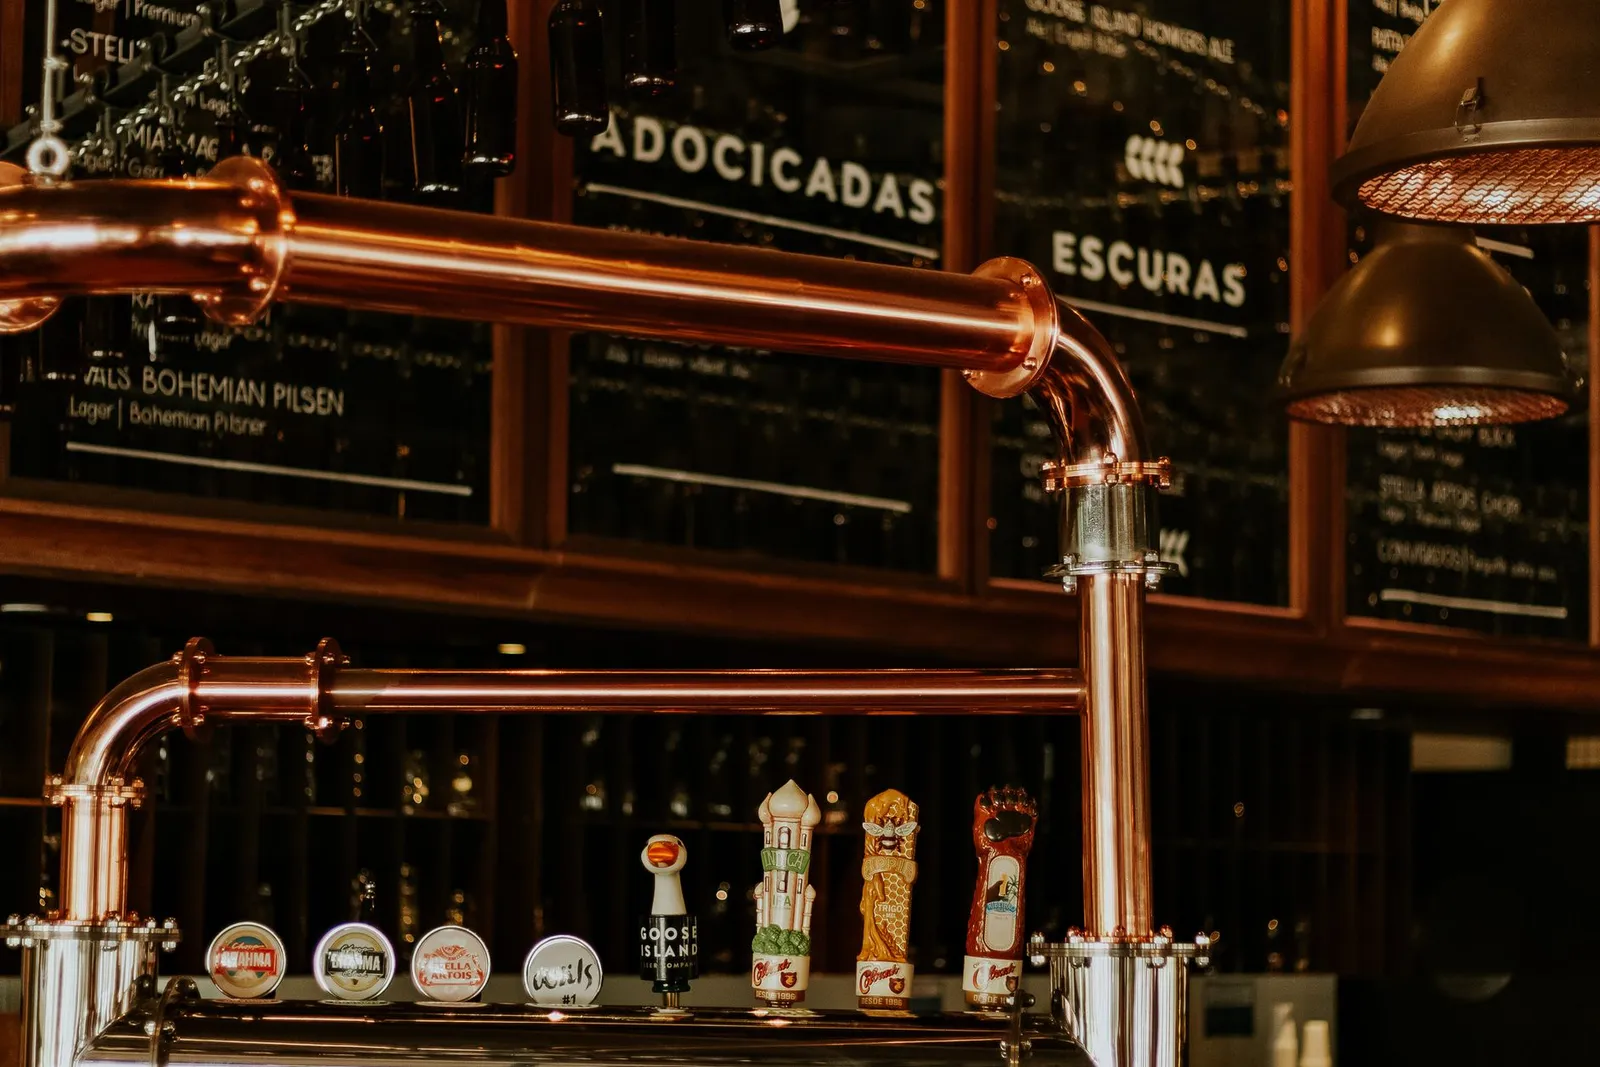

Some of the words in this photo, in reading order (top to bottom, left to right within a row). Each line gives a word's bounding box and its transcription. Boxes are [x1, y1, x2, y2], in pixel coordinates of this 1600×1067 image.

[590, 110, 936, 225] ADOCICADAS
[1052, 230, 1247, 308] ESCURAS
[142, 365, 266, 408] BOHEMIAN
[273, 381, 345, 417] PILSEN
[69, 394, 114, 425] Lager
[130, 400, 211, 433] Bohemian
[214, 410, 268, 437] Pilsner
[773, 895, 792, 907] IA
[878, 904, 903, 913] TRIGO
[640, 926, 698, 941] GOOSE
[640, 943, 698, 957] ISLAND
[220, 951, 271, 968] AHMA
[331, 951, 381, 971] BMA
[431, 971, 472, 980] ARTOIS
[972, 962, 1016, 990] Clorado
[562, 994, 576, 1004] #1
